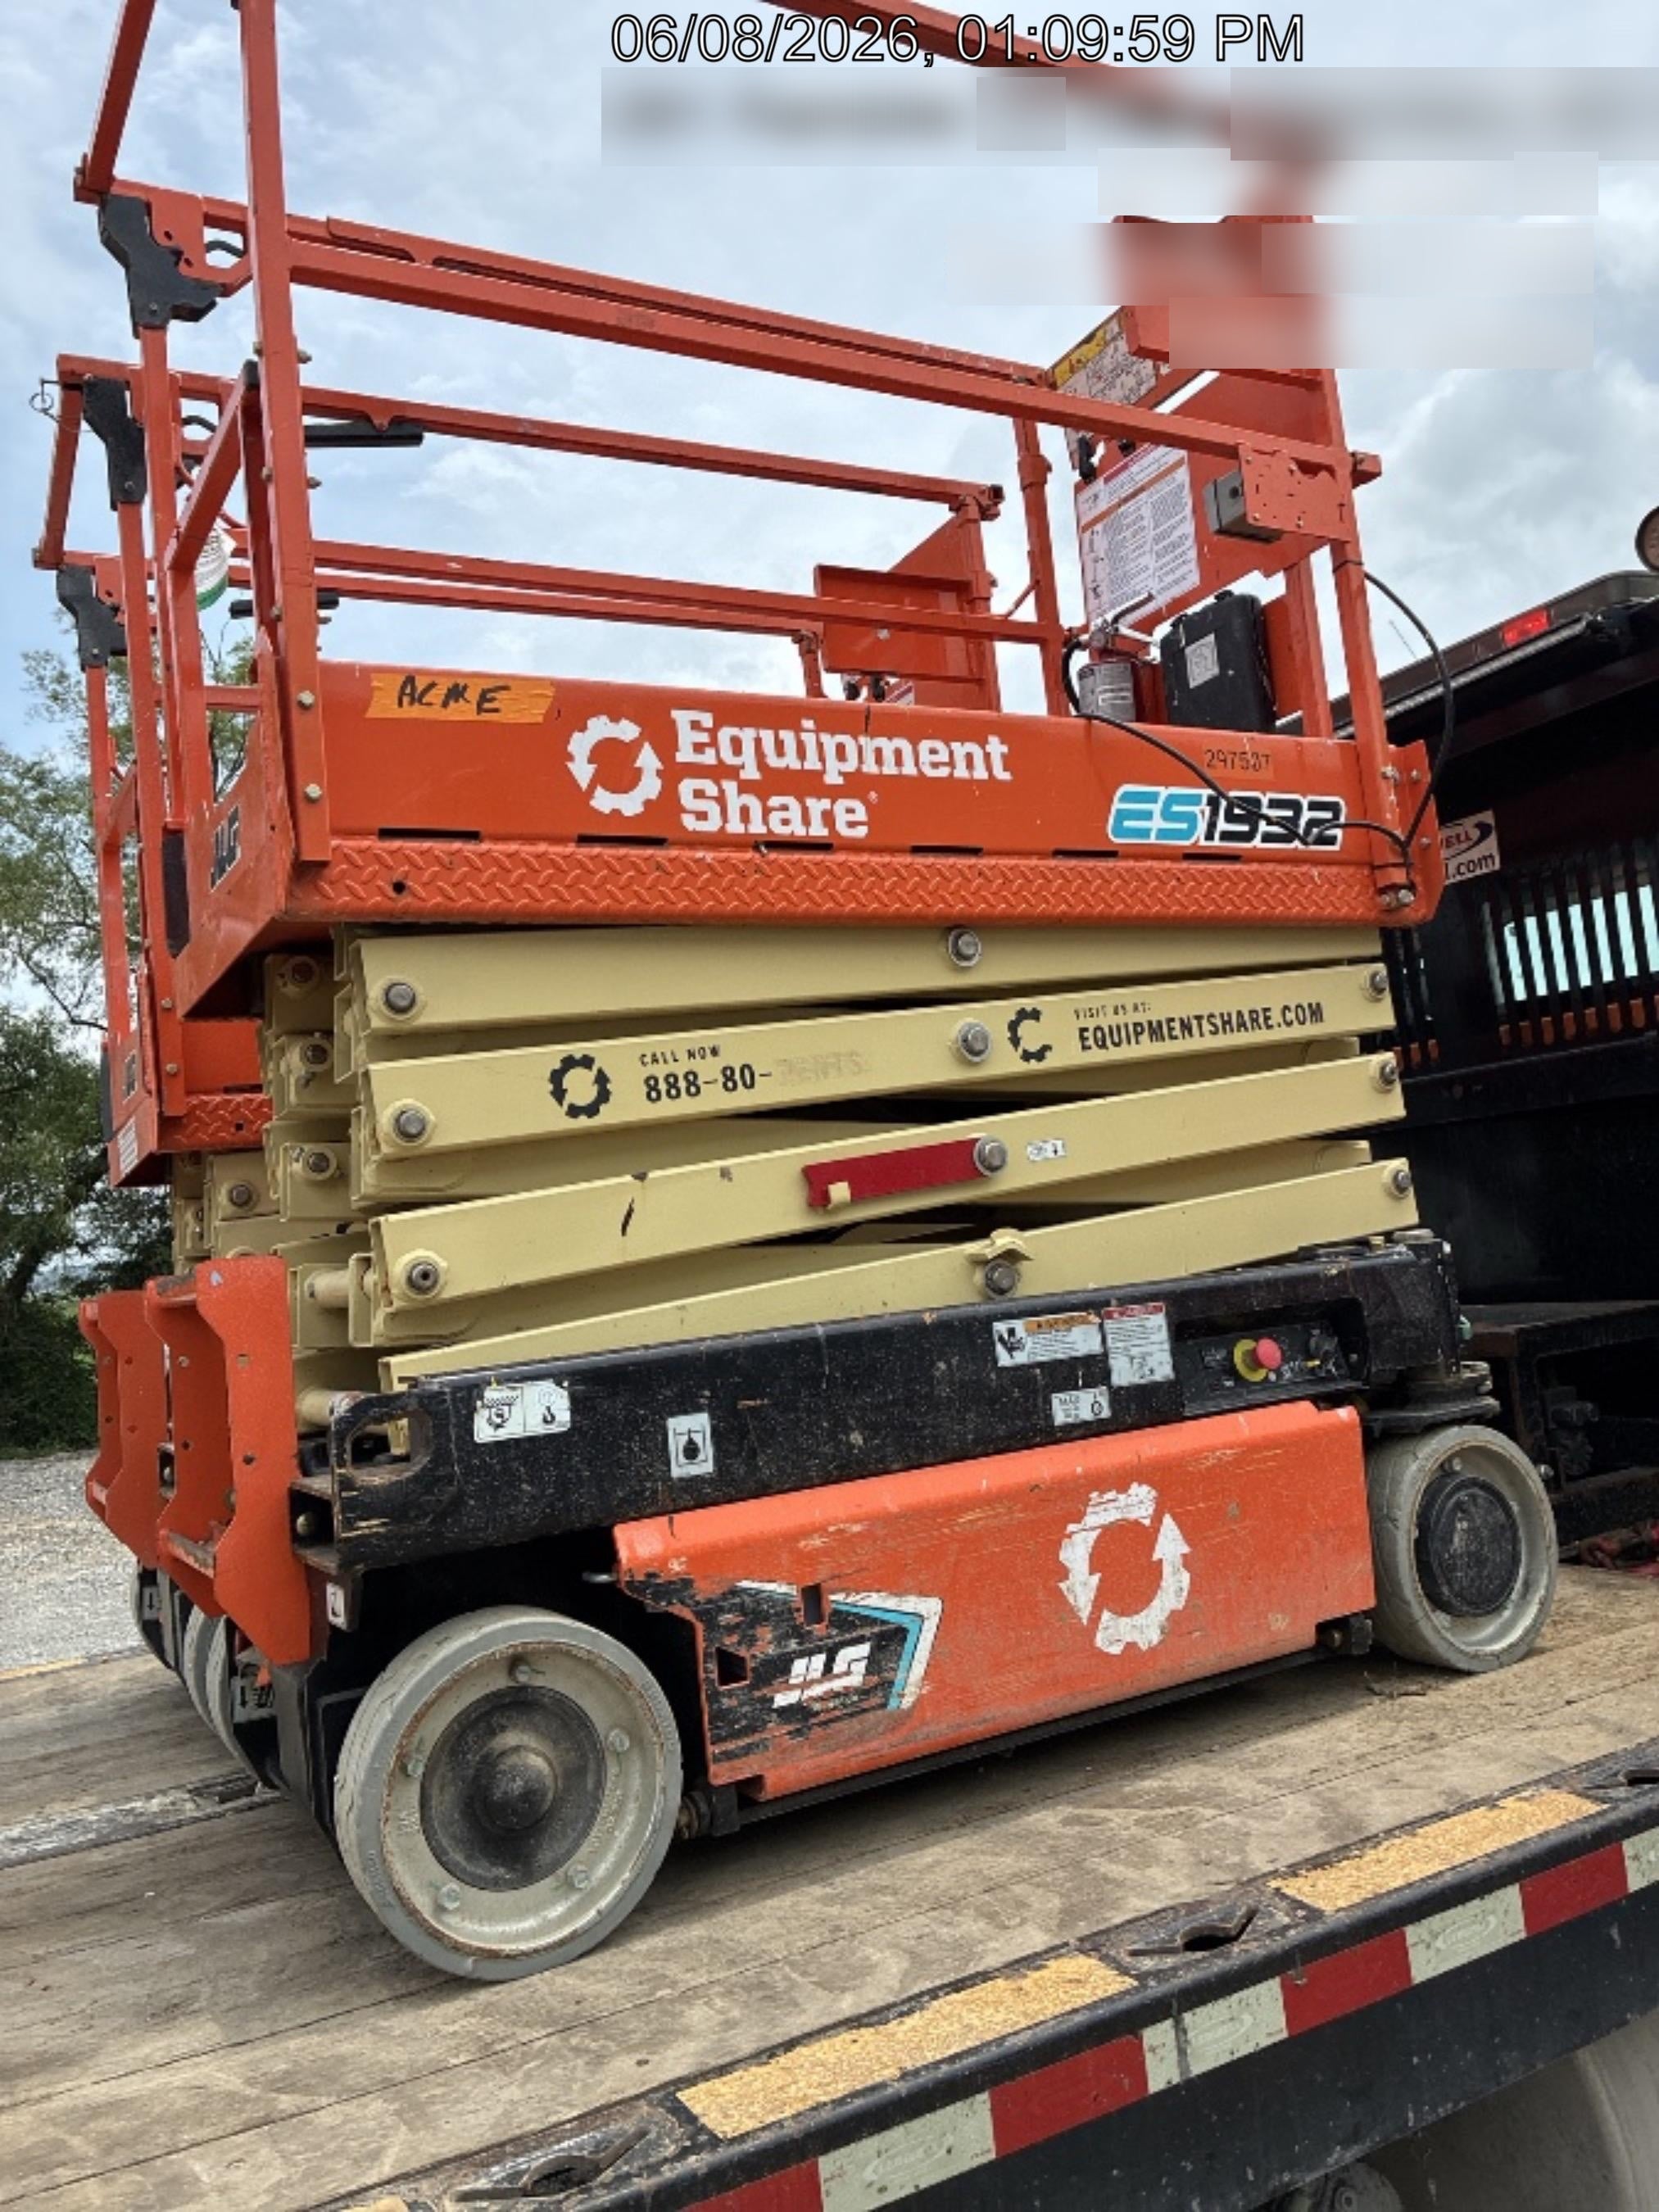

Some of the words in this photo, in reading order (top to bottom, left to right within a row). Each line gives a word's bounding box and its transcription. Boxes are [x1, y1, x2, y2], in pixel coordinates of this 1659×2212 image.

[397, 673, 511, 715] ACME
[670, 709, 1013, 785] Equipment
[1109, 789, 1344, 847] ES1932
[1439, 828, 1473, 849] ELL
[1078, 1002, 1324, 1052] EQUIPMENTSHARE.COM
[639, 1049, 679, 1067] CALL
[687, 1045, 721, 1061] NOW
